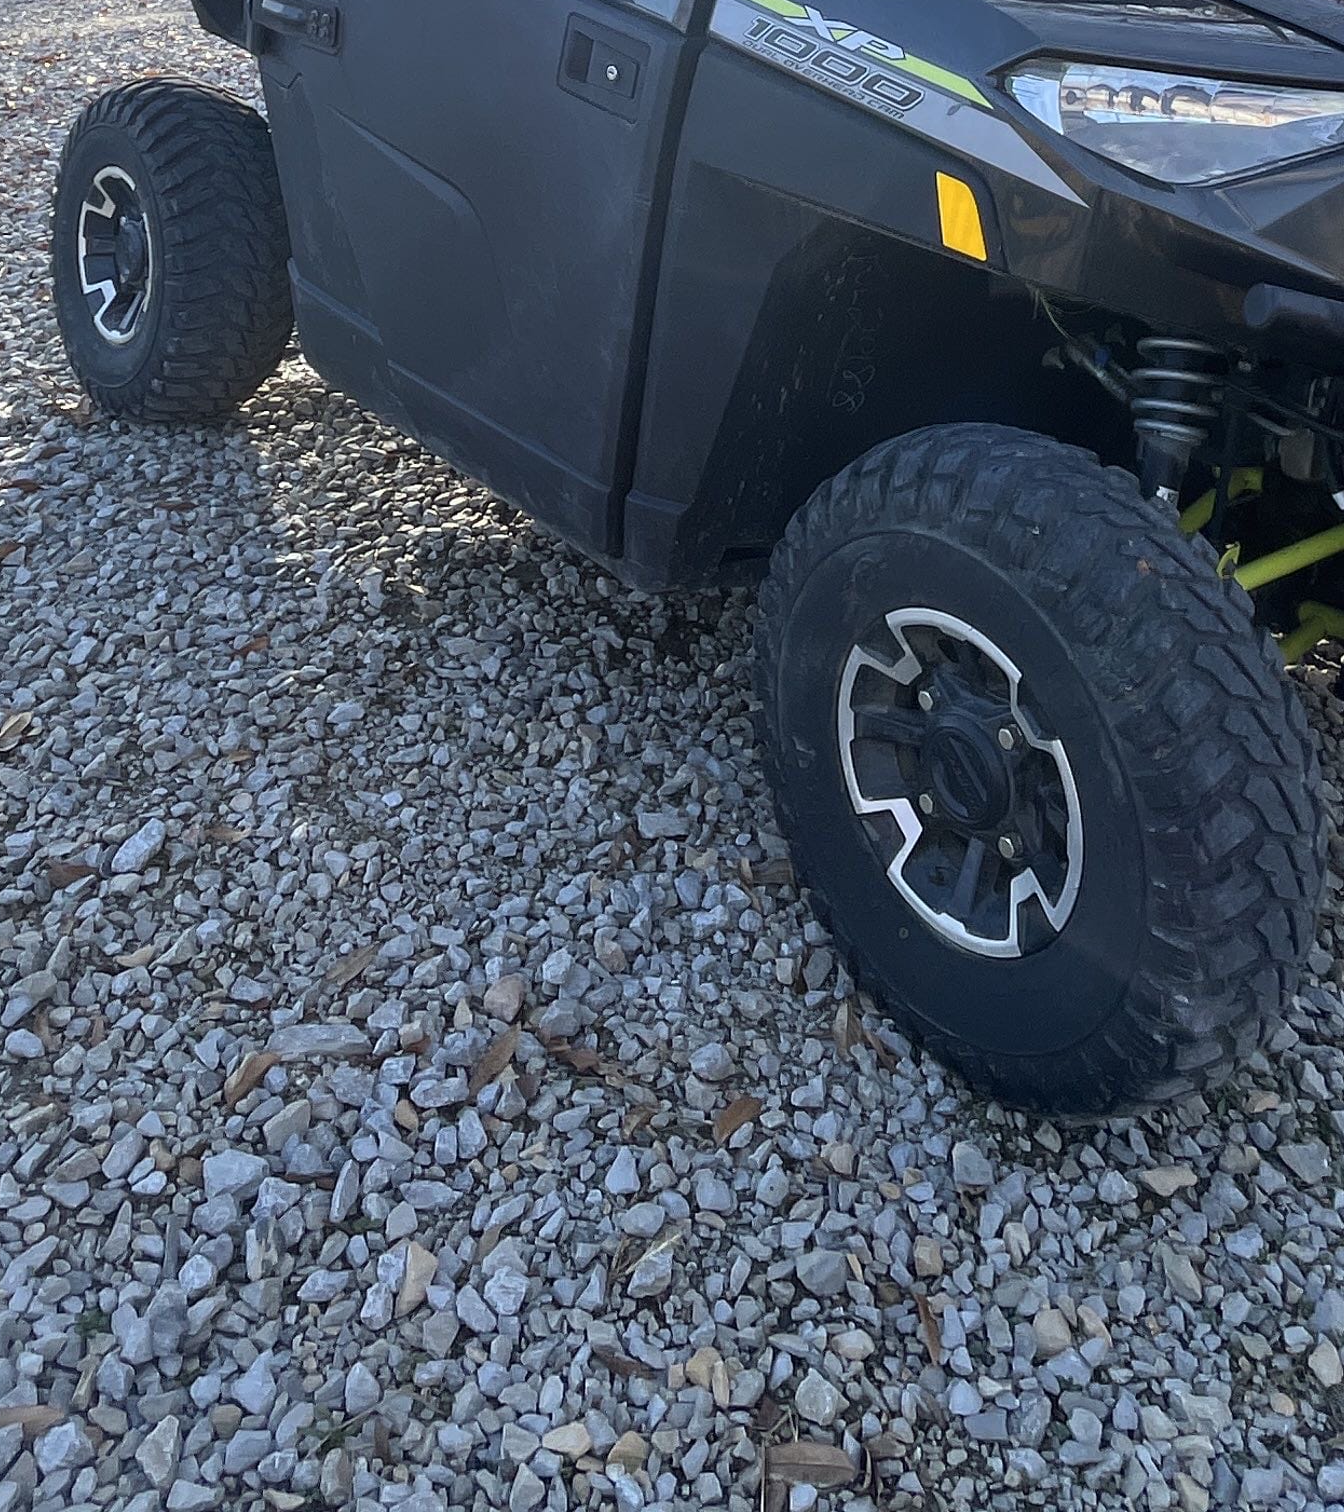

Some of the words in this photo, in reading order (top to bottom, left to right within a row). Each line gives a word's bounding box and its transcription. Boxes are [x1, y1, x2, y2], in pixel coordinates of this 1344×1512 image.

[743, 15, 926, 111] 1000
[783, 4, 906, 61] XP
[742, 40, 779, 62] DUAL
[783, 58, 865, 102] OVERHEAD
[867, 99, 905, 120] CAM
